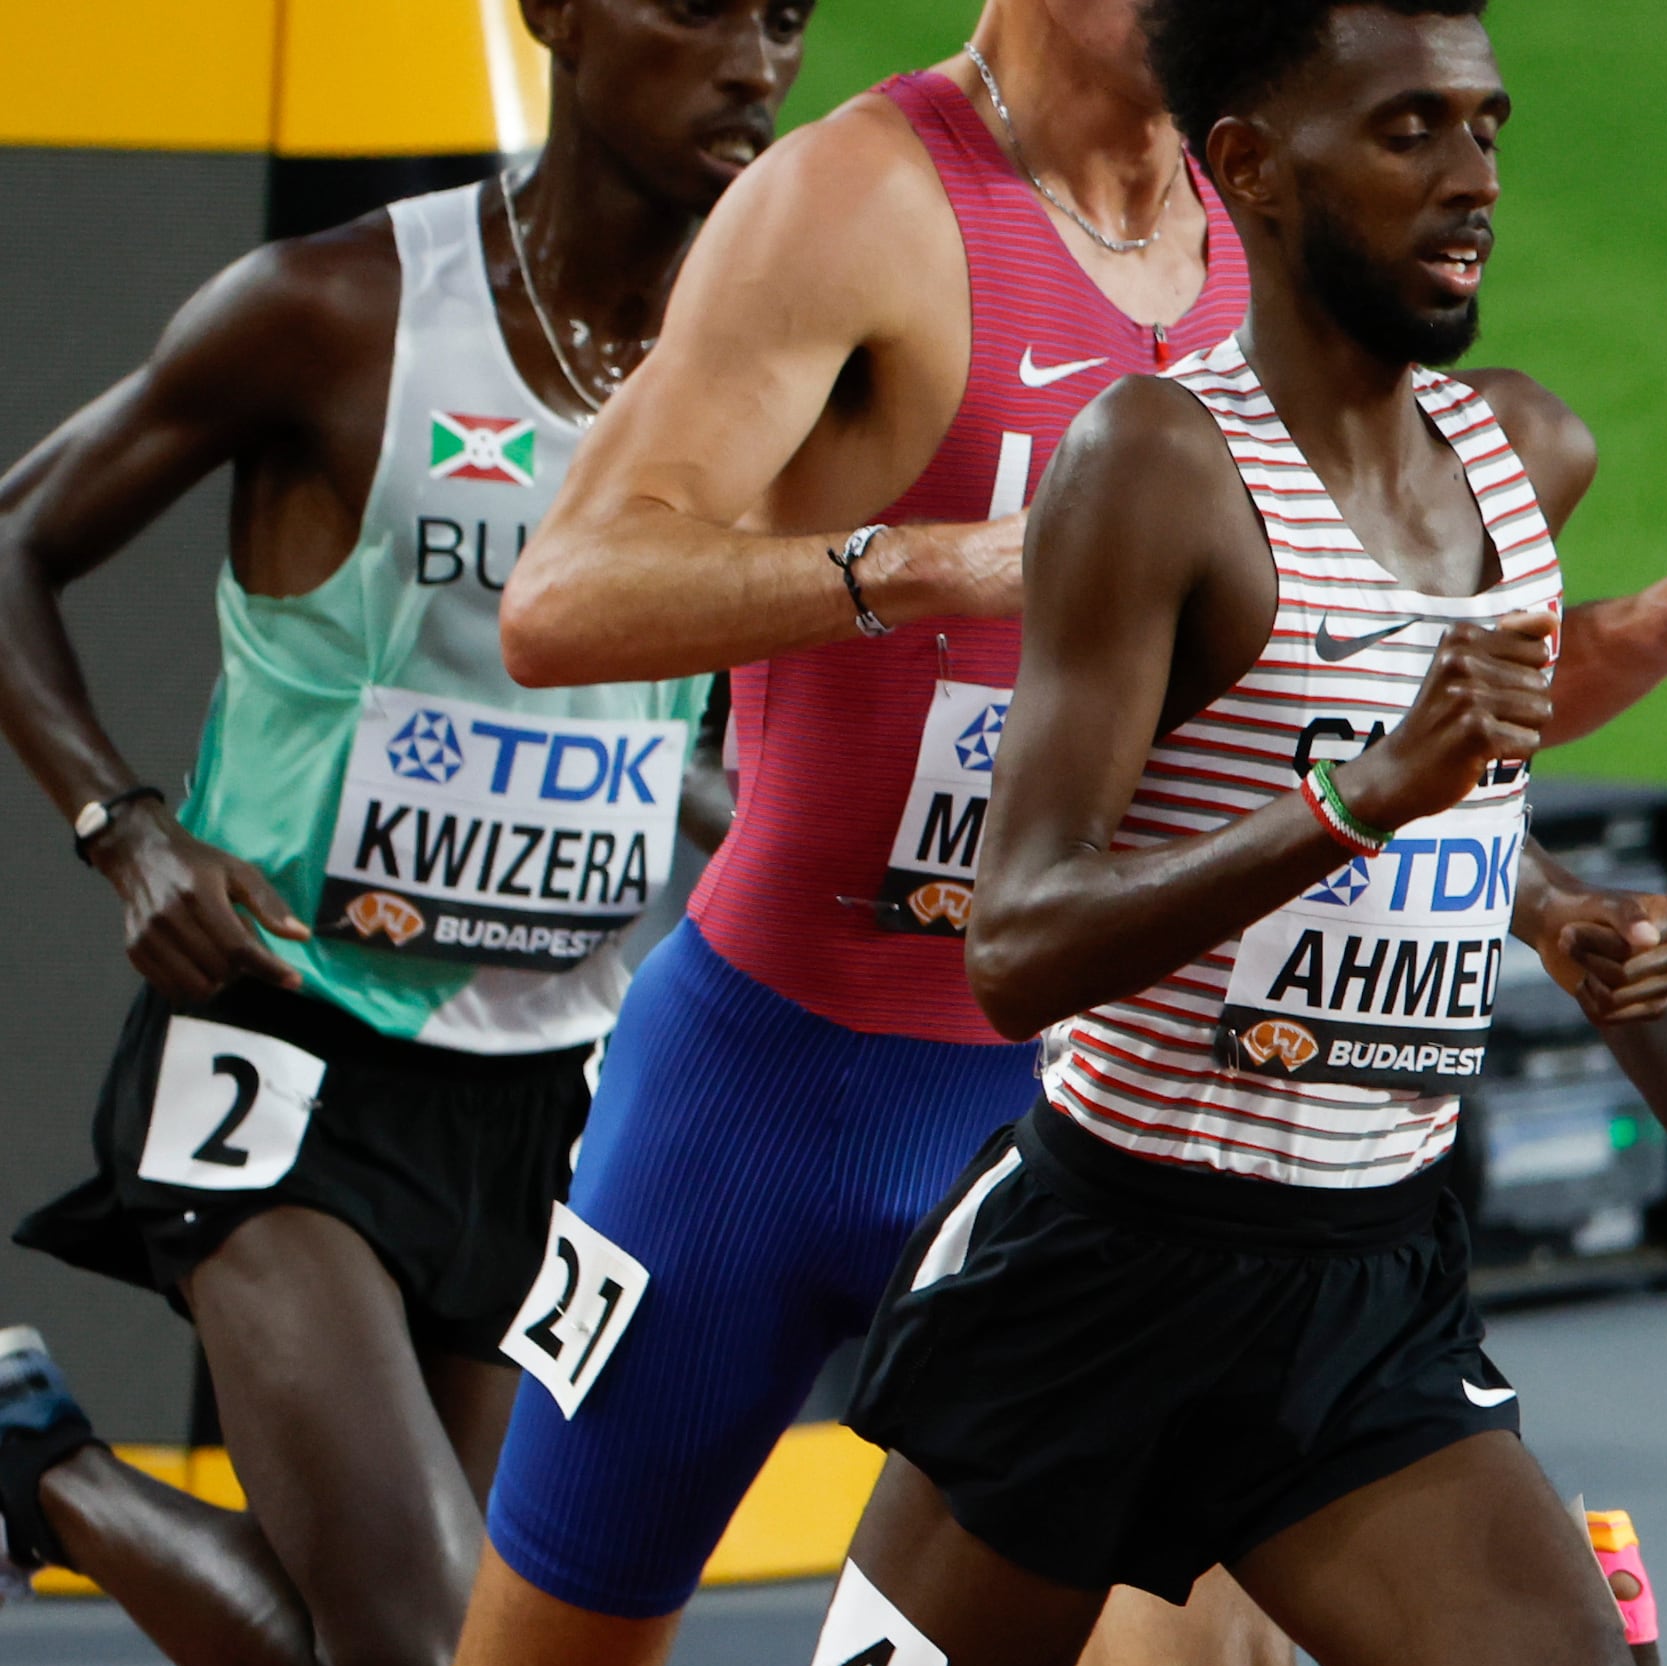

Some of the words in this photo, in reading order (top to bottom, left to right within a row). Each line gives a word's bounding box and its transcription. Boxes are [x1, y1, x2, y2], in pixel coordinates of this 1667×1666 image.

[470, 720, 666, 804] TDK
[354, 798, 648, 904] KWIZERA
[1381, 832, 1519, 912] TDK
[1267, 928, 1503, 1018] AHMED
[1327, 1039, 1486, 1076] BUDAPEST
[190, 1053, 262, 1168] 2
[523, 1236, 625, 1388] 21
